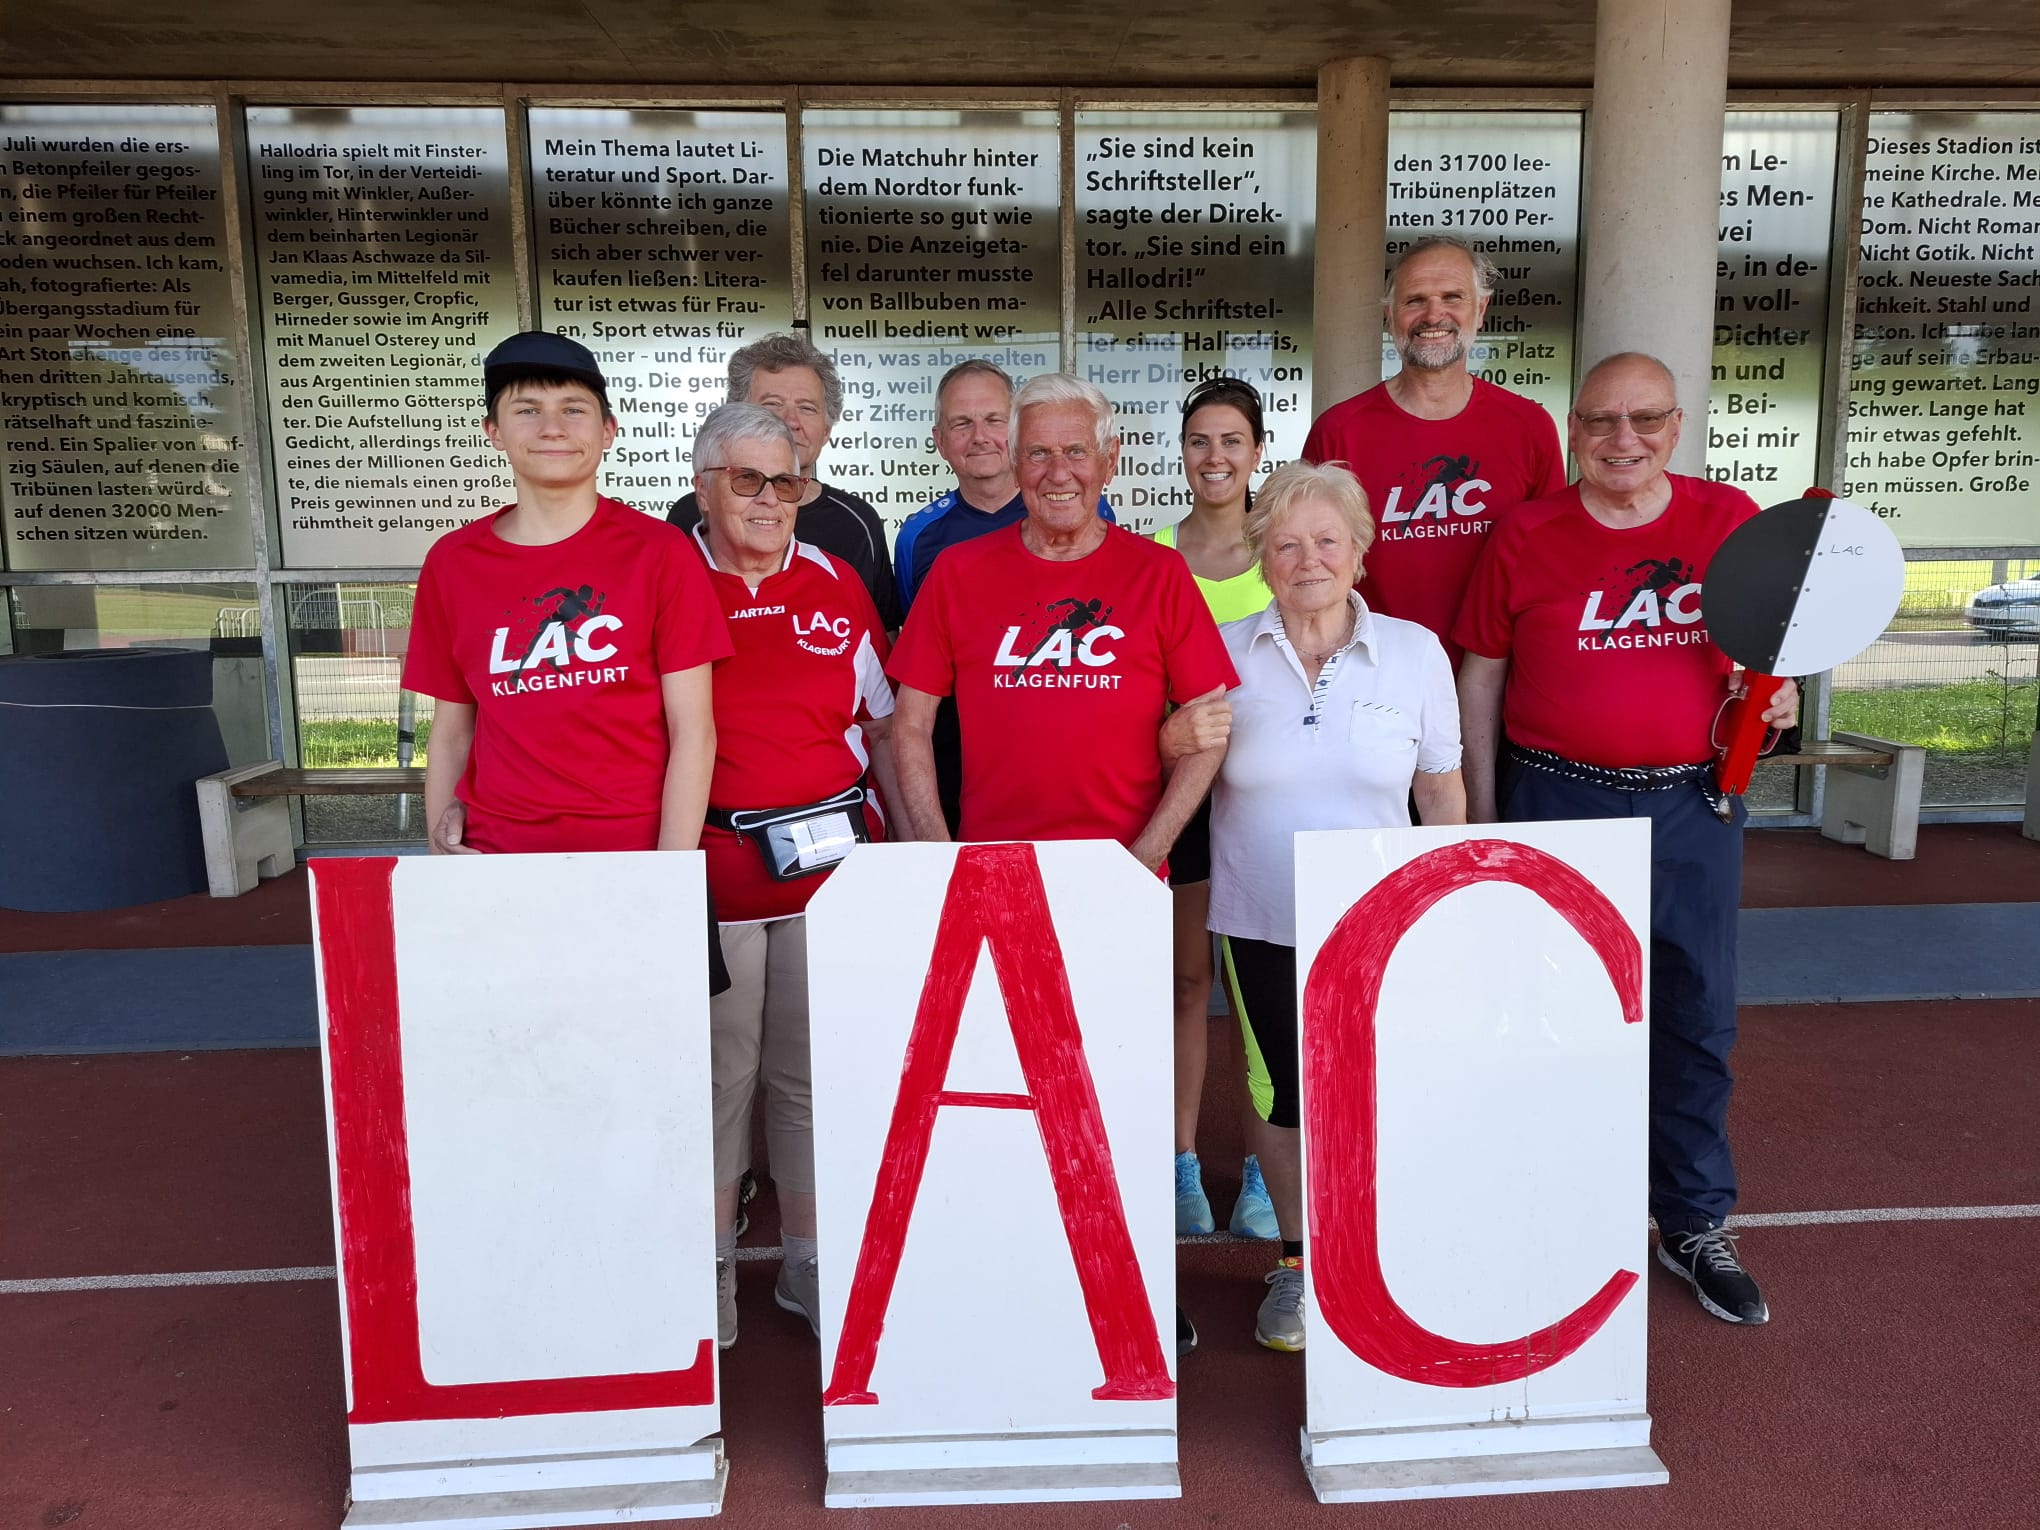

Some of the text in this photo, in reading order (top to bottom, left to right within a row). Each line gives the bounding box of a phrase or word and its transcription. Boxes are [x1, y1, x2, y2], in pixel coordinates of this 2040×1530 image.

[3, 136, 189, 153] Juli wurden die ers-
[260, 143, 487, 161] Hallodria spielt mit Finster-
[546, 139, 763, 157] Mein Thema lautet Li-
[1087, 137, 1253, 161] „Sie sind kein
[1867, 137, 1930, 154] Dieses
[1936, 137, 2012, 154] Stadion
[818, 148, 1038, 167] Die Matchuhr hinter
[1394, 154, 1550, 171] den 31700 lee-
[1750, 149, 1787, 171] Le-
[13, 160, 200, 181] Betonpfeiler gegos-
[262, 165, 482, 182] ling im Tor, in der Verteidi-
[546, 166, 774, 188] teratur und Sport. Dar-
[819, 176, 1023, 196] dem Nordtor funk-
[1087, 169, 1259, 193] Schriftsteller“,
[548, 191, 773, 214] über könnte ich ganze
[1389, 181, 1555, 204] Tribünenplätzen
[1747, 185, 1813, 206] Men-
[819, 206, 1032, 230] tionierte so gut wie
[1087, 202, 1282, 230] sagte der Direk-
[1441, 209, 1553, 226] 31700 Per-
[1086, 234, 1284, 259] tor. „Sie sind ein
[1473, 235, 1561, 254] nehmen,
[1859, 243, 2034, 261] Nicht Gotik. Nicht
[1745, 254, 1817, 276] in de-
[1088, 267, 1205, 288] Hallodri!“
[273, 291, 478, 309] Berger, Gussger, Cropfic,
[554, 295, 765, 313] tur ist etwas für Frau-
[823, 292, 1026, 310] von Ballbuben ma-
[1743, 289, 1799, 311] voll-
[275, 312, 489, 329] Hirneder sowie im Angriff
[1087, 298, 1283, 323] „Alle Schriftstel-
[277, 333, 475, 350] mit Manuel Osterey und
[556, 321, 744, 342] en, Sport etwas für
[1507, 341, 1554, 359] Platz
[1513, 368, 1550, 385] ein-
[1736, 358, 1784, 380] und
[1728, 393, 1776, 414] Bei-
[1848, 399, 2025, 421] Schwer. Lange hat
[4, 414, 213, 429] rätselhaft und faszinie-
[1709, 427, 1799, 448] bei mir
[1848, 425, 2021, 446] mir etwas gefehlt.
[9, 458, 239, 478] zig Säulen, auf denen die
[829, 460, 940, 476] war. Unter
[1878, 451, 1925, 467] habe
[1932, 450, 1989, 472] Opfer
[1843, 475, 2029, 499] gen müssen. Große
[14, 504, 43, 518] auf
[49, 504, 106, 518] denen
[177, 504, 223, 517] Men-
[291, 495, 506, 512] Preis gewinnen und zu Be-
[1381, 479, 1492, 523] LAC
[17, 525, 208, 540] schen sitzen würden.
[1381, 521, 1492, 541] KLAGENFURT
[1831, 543, 1864, 556] LAC
[729, 605, 785, 619] JARTAZI
[1578, 582, 1702, 631] LAC
[793, 611, 850, 638] LAC
[489, 615, 623, 674] LAC
[797, 638, 851, 656] KLAGENFURT
[993, 625, 1125, 668] LAC
[491, 666, 629, 697] KLAGENFURT
[994, 673, 1122, 690] KLAGENFURT
